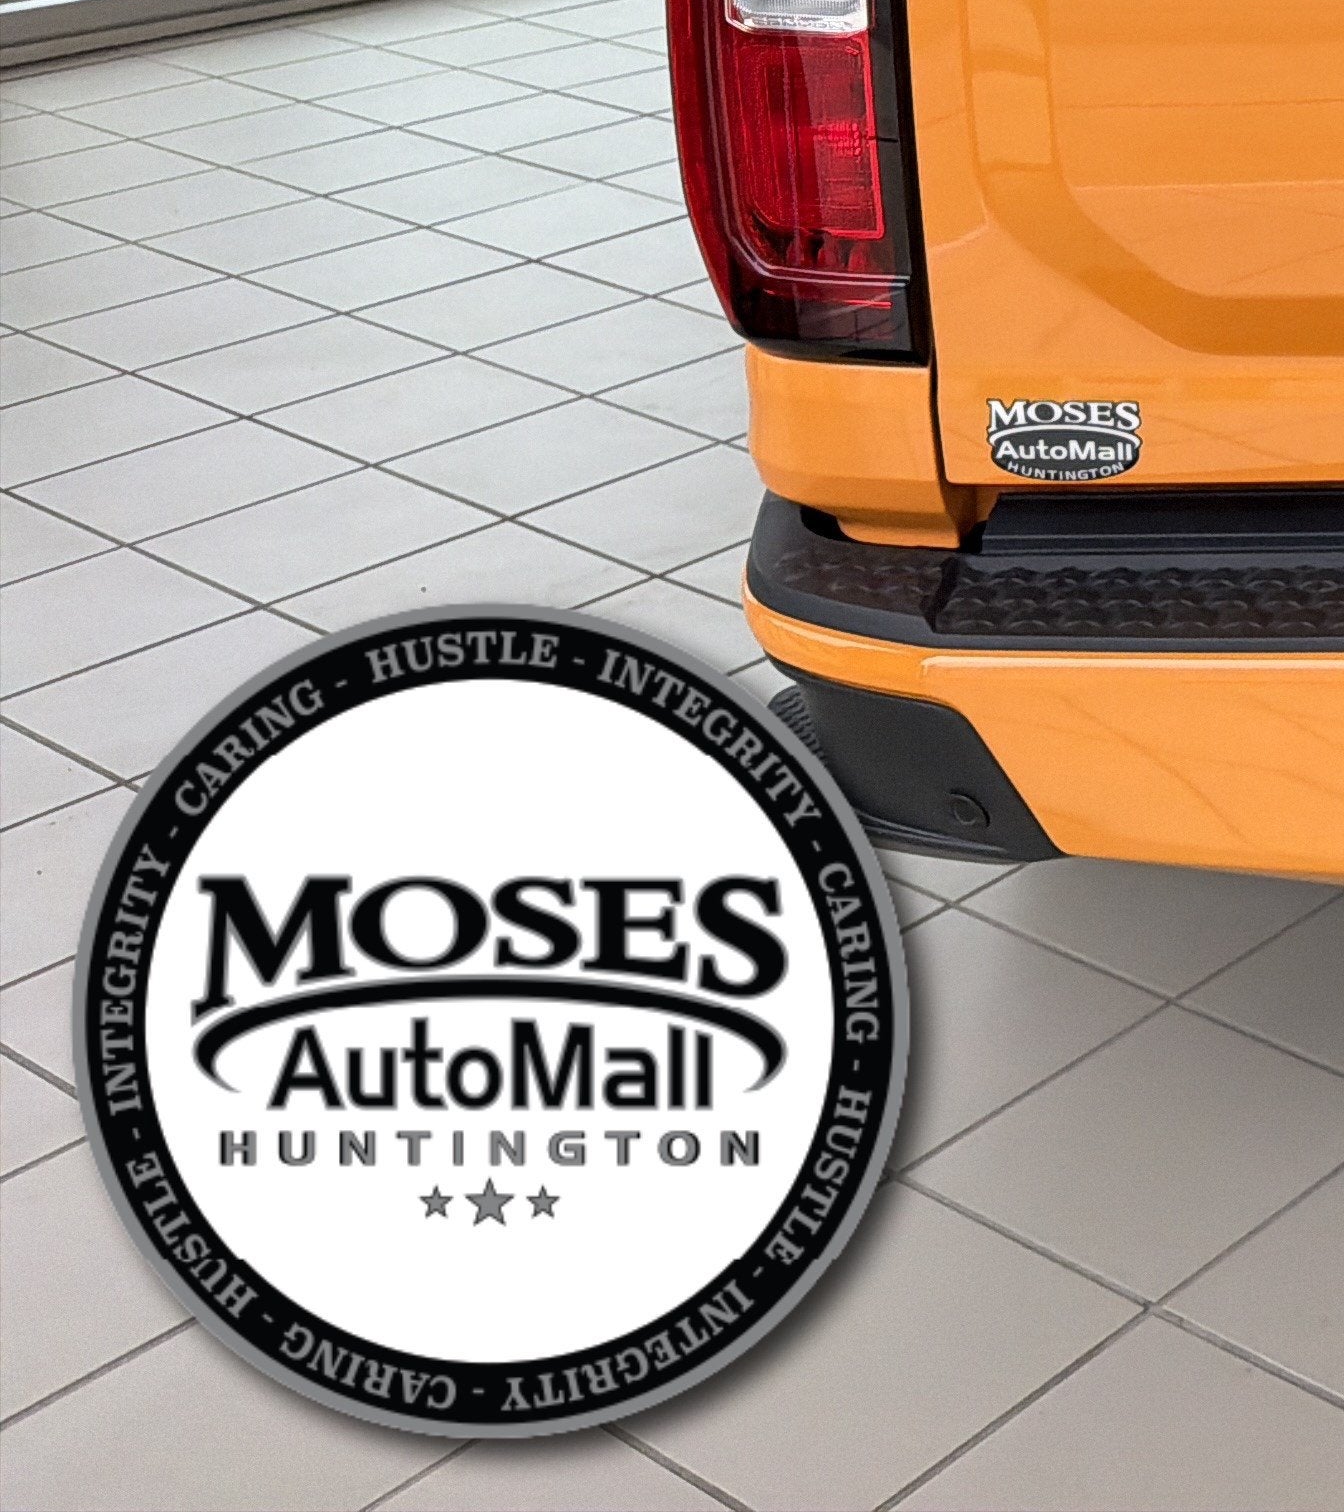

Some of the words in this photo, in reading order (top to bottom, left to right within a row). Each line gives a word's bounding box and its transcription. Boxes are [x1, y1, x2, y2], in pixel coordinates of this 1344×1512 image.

[987, 399, 1141, 433] MOSES
[995, 438, 1133, 462] AutoMall
[1006, 459, 1125, 481] HUNTINGTON
